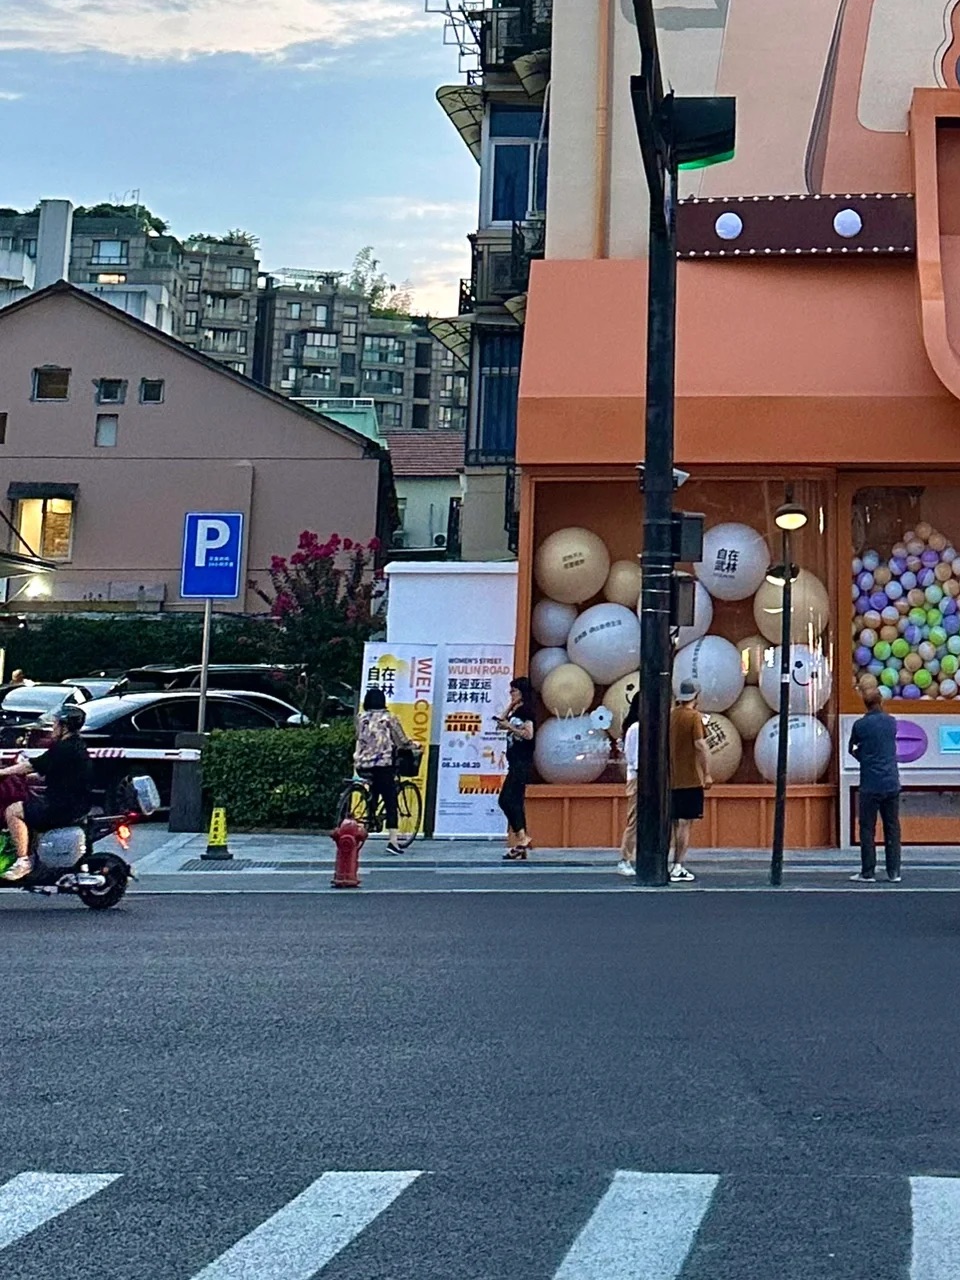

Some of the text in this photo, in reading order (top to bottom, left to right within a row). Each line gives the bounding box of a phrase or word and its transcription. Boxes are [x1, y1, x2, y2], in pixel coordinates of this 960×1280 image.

[195, 519, 231, 567] P
[367, 666, 396, 681] 自在
[448, 665, 510, 675] WULIN ROAD
[447, 678, 492, 690] 喜迎亚运
[412, 657, 433, 748] WELCOM
[446, 691, 492, 703] 武林有礼
